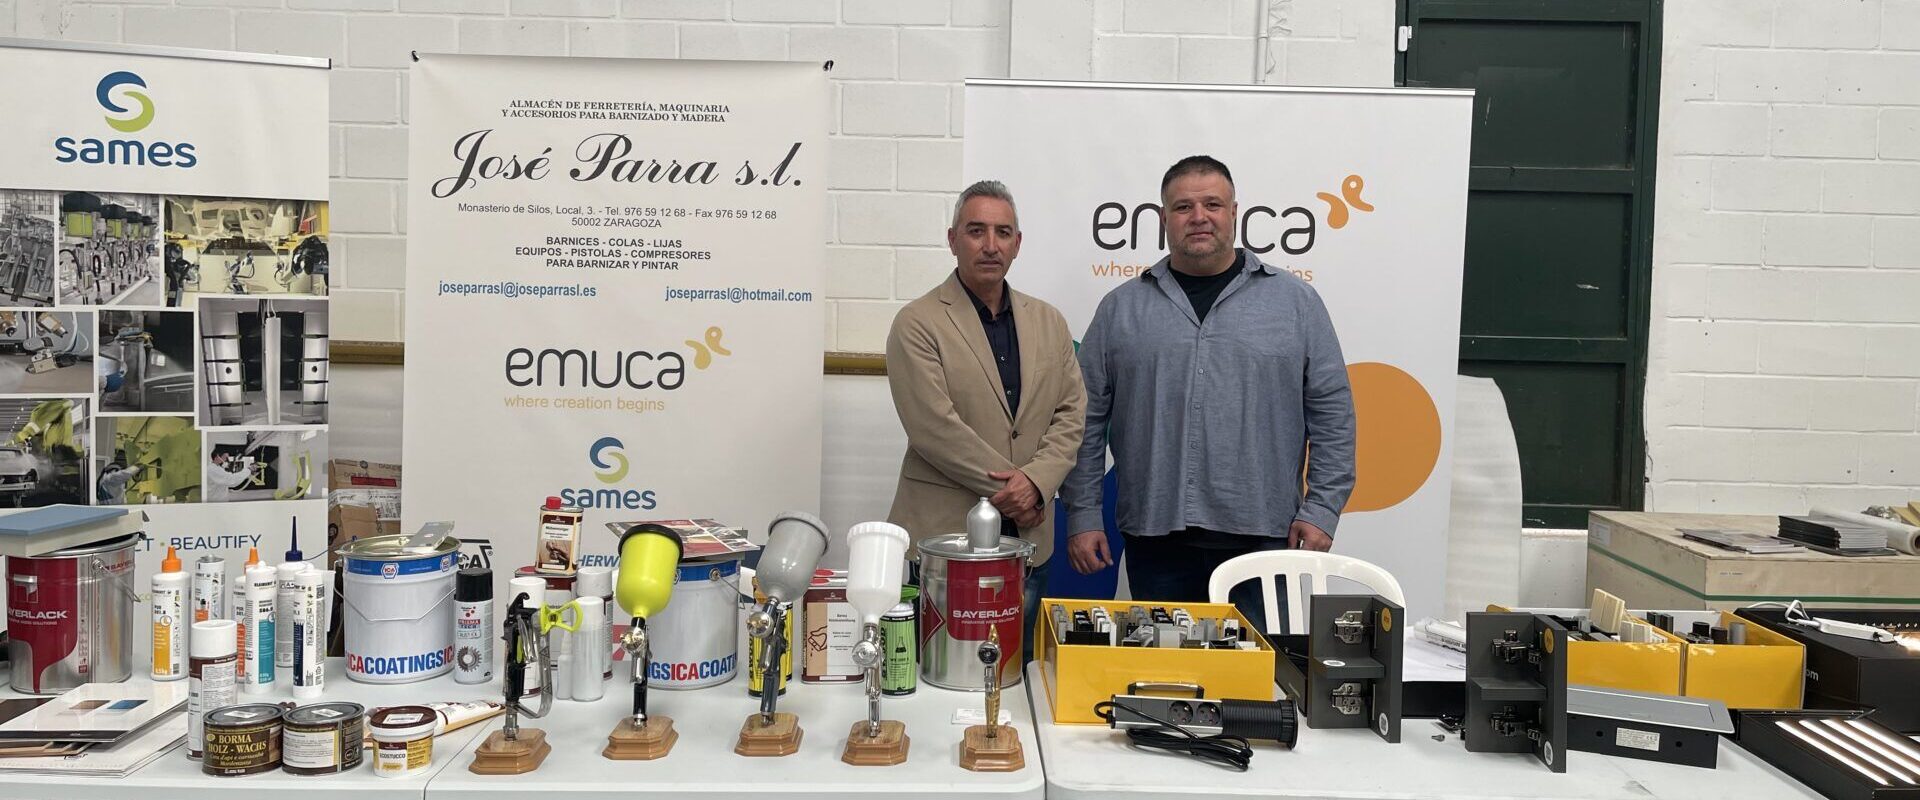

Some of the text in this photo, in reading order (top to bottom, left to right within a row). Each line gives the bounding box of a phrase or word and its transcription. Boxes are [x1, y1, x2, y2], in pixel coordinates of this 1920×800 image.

[509, 99, 730, 113] ALMACÉN DE FERRETERÍA, MAQUINARIA
[501, 109, 726, 123] Y ACCESORIOS PARA BARNIZADO Y MADERA
[54, 136, 197, 168] sames
[431, 129, 803, 199] José Parra s.l.
[458, 203, 510, 213] Monasterio
[512, 204, 525, 214] de
[527, 204, 553, 215] Silos,
[556, 206, 584, 216] Local,
[604, 206, 622, 216] Tel.
[624, 207, 642, 217] 976
[645, 207, 657, 217] 59
[660, 208, 671, 217] 12
[673, 208, 686, 217] 68
[695, 208, 713, 218] Fax
[715, 209, 734, 218] 976
[736, 210, 748, 219] 59
[751, 210, 762, 219] 12
[764, 210, 777, 219] 68
[571, 217, 662, 228] 50002 ZARAGOZA
[1092, 202, 1316, 255] emca
[546, 236, 600, 246] BARNICES
[608, 238, 644, 247] COLAS
[653, 239, 682, 248] LIJAS
[515, 247, 562, 257] EQUIPOS
[571, 248, 622, 258] PISTOLAS
[630, 250, 711, 260] COMPRESORES
[546, 258, 679, 270] PARA BARNIZAR Y PINTAR
[1092, 261, 1151, 277] wher
[438, 281, 597, 298] joseparrasl@joseparrasl.es
[665, 285, 813, 303] joseparrasl@hotmail.com
[505, 347, 685, 391] emuca
[504, 394, 665, 413] where creation begins
[560, 487, 657, 510] sames
[170, 534, 262, 551] BEAUTIFY
[577, 554, 619, 567] HERW
[8, 606, 67, 619] AYERLACK
[952, 606, 1020, 618] SAYERLACK
[218, 734, 252, 744] BORMA
[208, 743, 228, 754] HOLZ
[236, 740, 267, 753] WACHS
